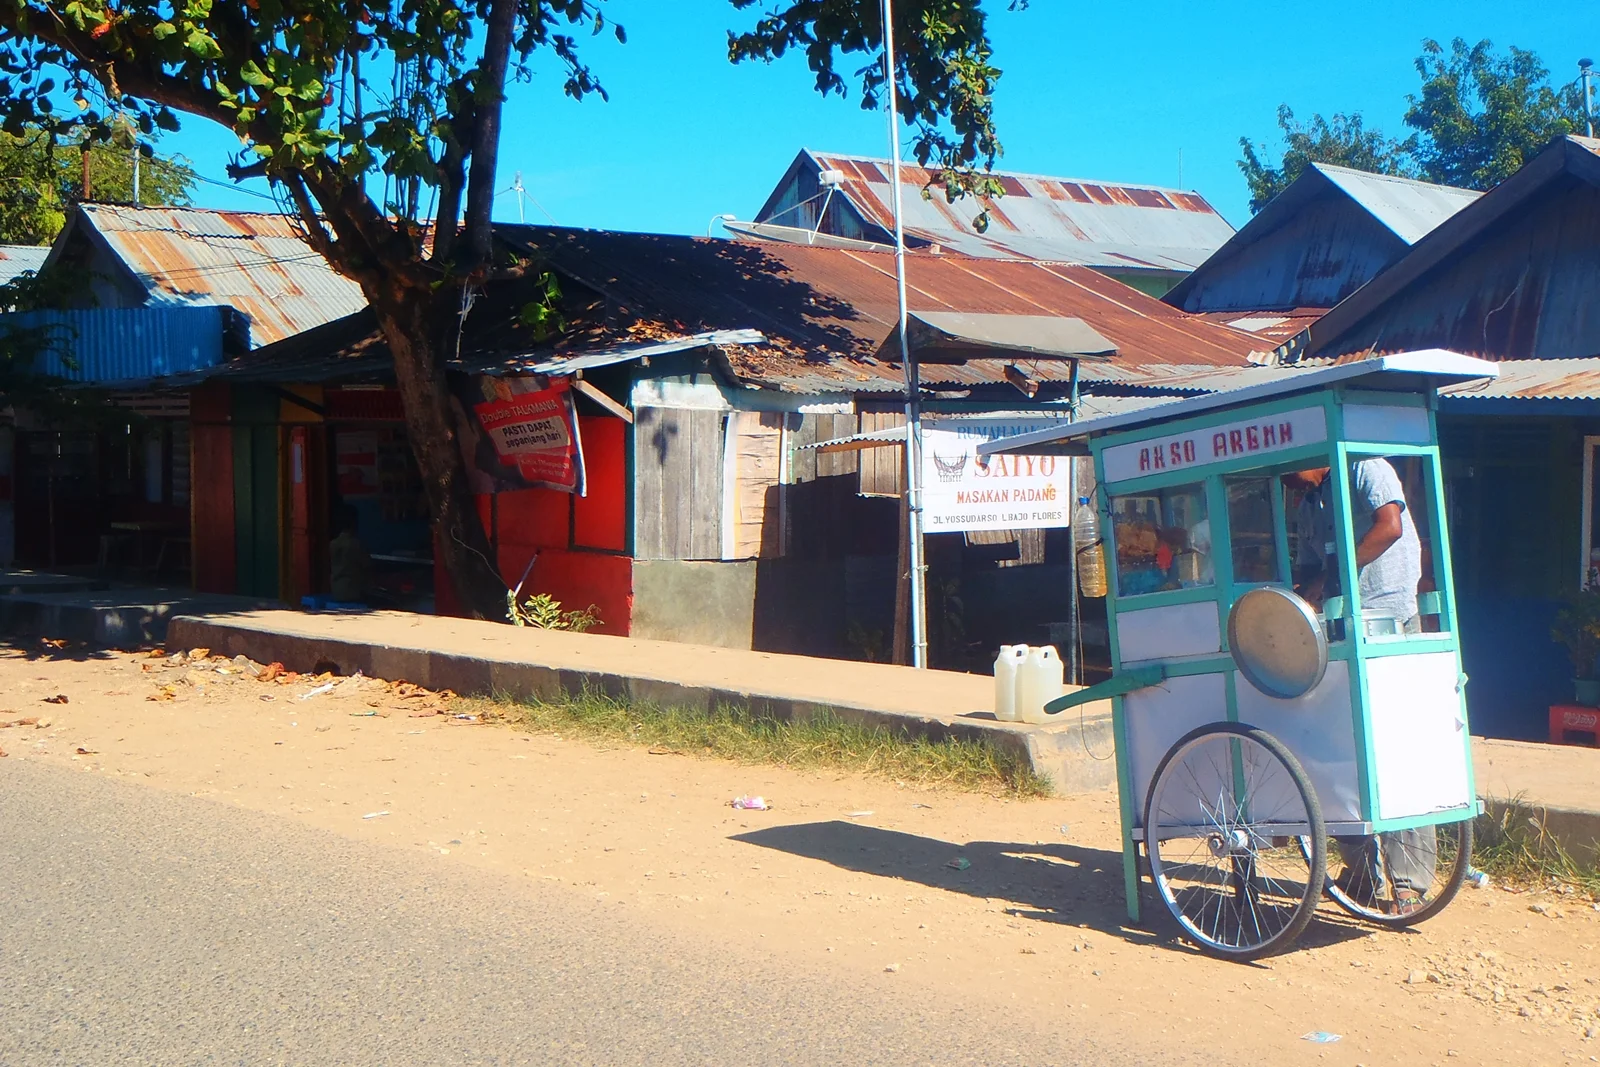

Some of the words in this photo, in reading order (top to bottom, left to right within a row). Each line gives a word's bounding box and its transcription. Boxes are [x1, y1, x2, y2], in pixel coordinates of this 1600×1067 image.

[481, 409, 512, 423] Double
[512, 400, 559, 416] TALKMANIA
[502, 427, 526, 437] PASTI
[505, 434, 546, 447] sepanjang
[546, 431, 561, 441] hari
[957, 426, 1006, 439] RUMAH
[1139, 440, 1196, 471] AKSO
[974, 455, 1055, 478] SAIYO
[957, 489, 1009, 504] MASAKAN
[1012, 487, 1057, 501] PADANG
[1032, 511, 1062, 520] FLORES
